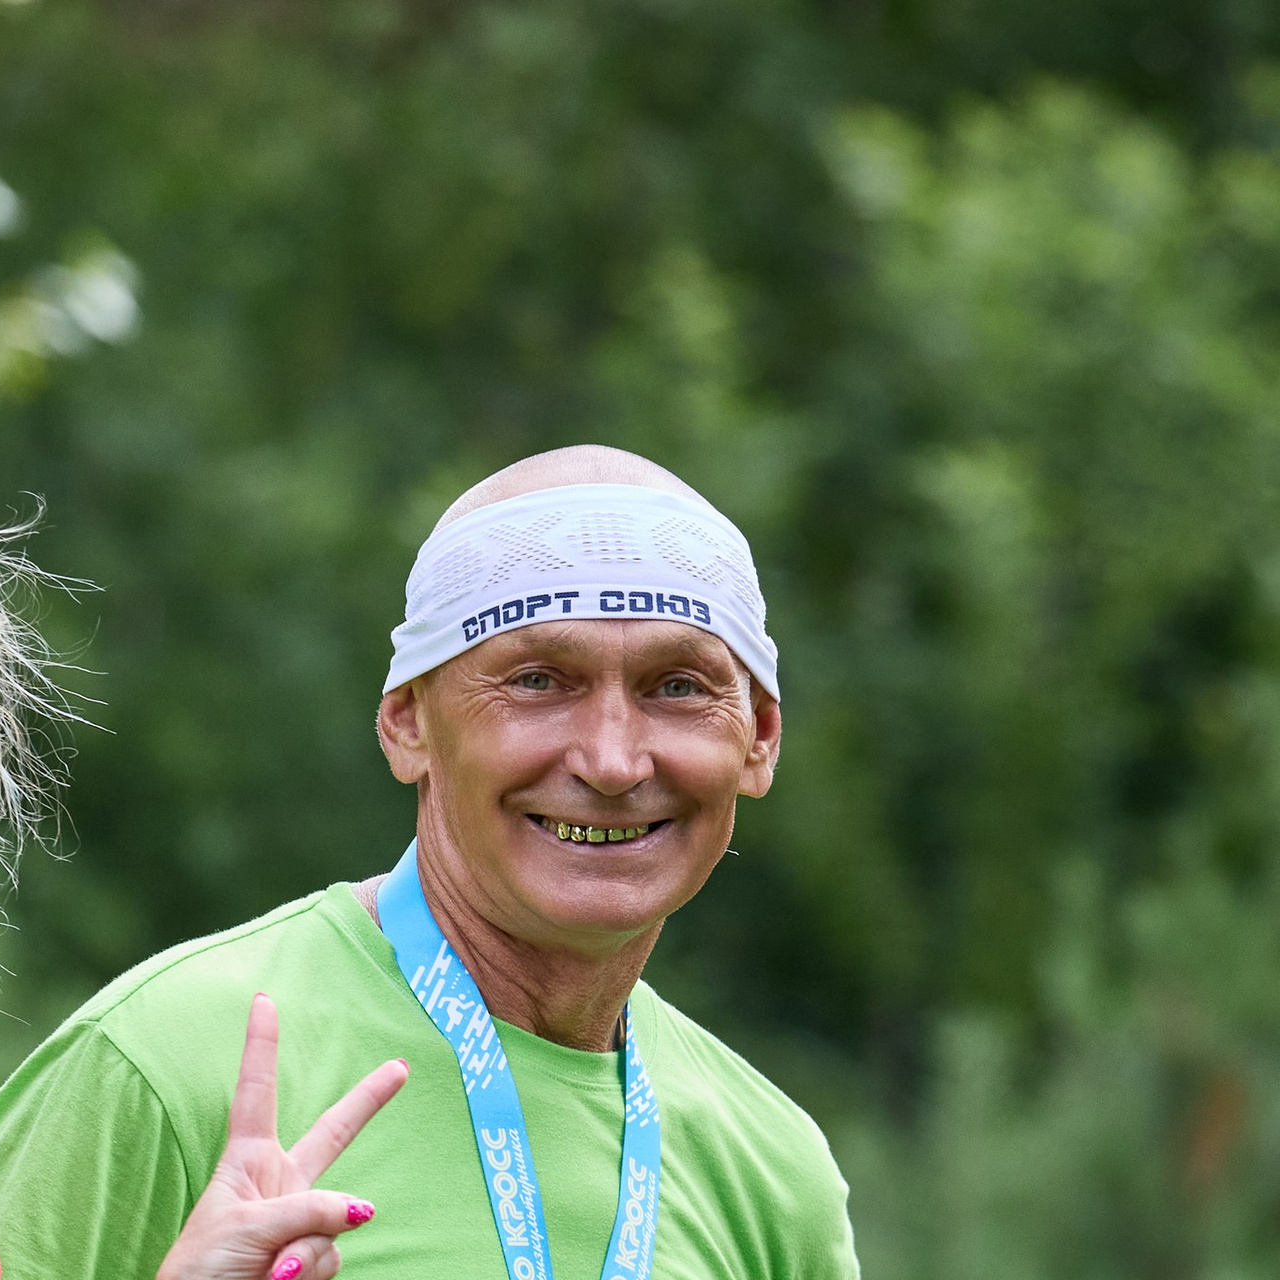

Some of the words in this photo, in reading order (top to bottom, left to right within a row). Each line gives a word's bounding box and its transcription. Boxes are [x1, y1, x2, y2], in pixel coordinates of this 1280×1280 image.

[462, 591, 579, 642] СПОРТ
[600, 591, 710, 626] СОЮЗ
[482, 1128, 529, 1247] КРОСС
[615, 1157, 648, 1270] КРОСС
